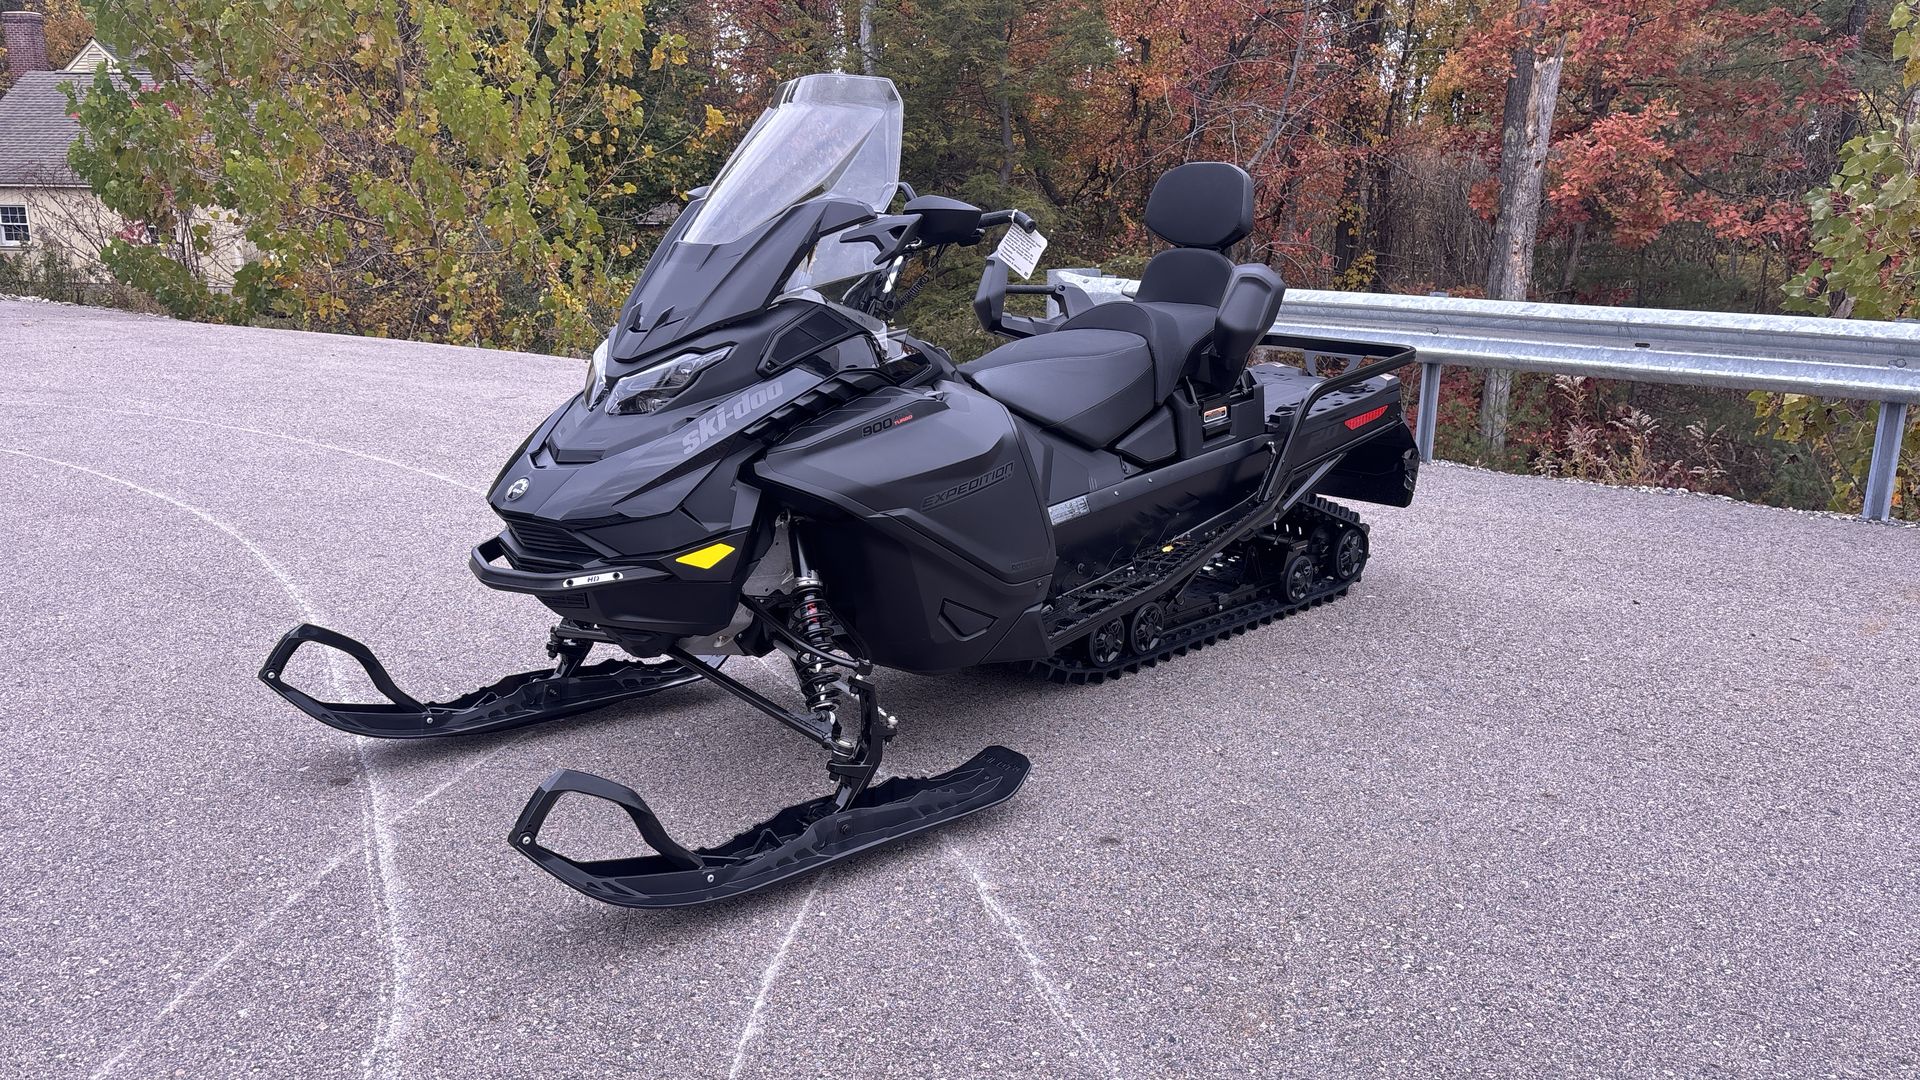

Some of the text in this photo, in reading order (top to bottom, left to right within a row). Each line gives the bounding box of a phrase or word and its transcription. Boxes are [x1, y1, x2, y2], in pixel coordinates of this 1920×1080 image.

[682, 381, 784, 455] ski-doo
[862, 417, 892, 437] 900
[921, 462, 1014, 509] EXPEDITION
